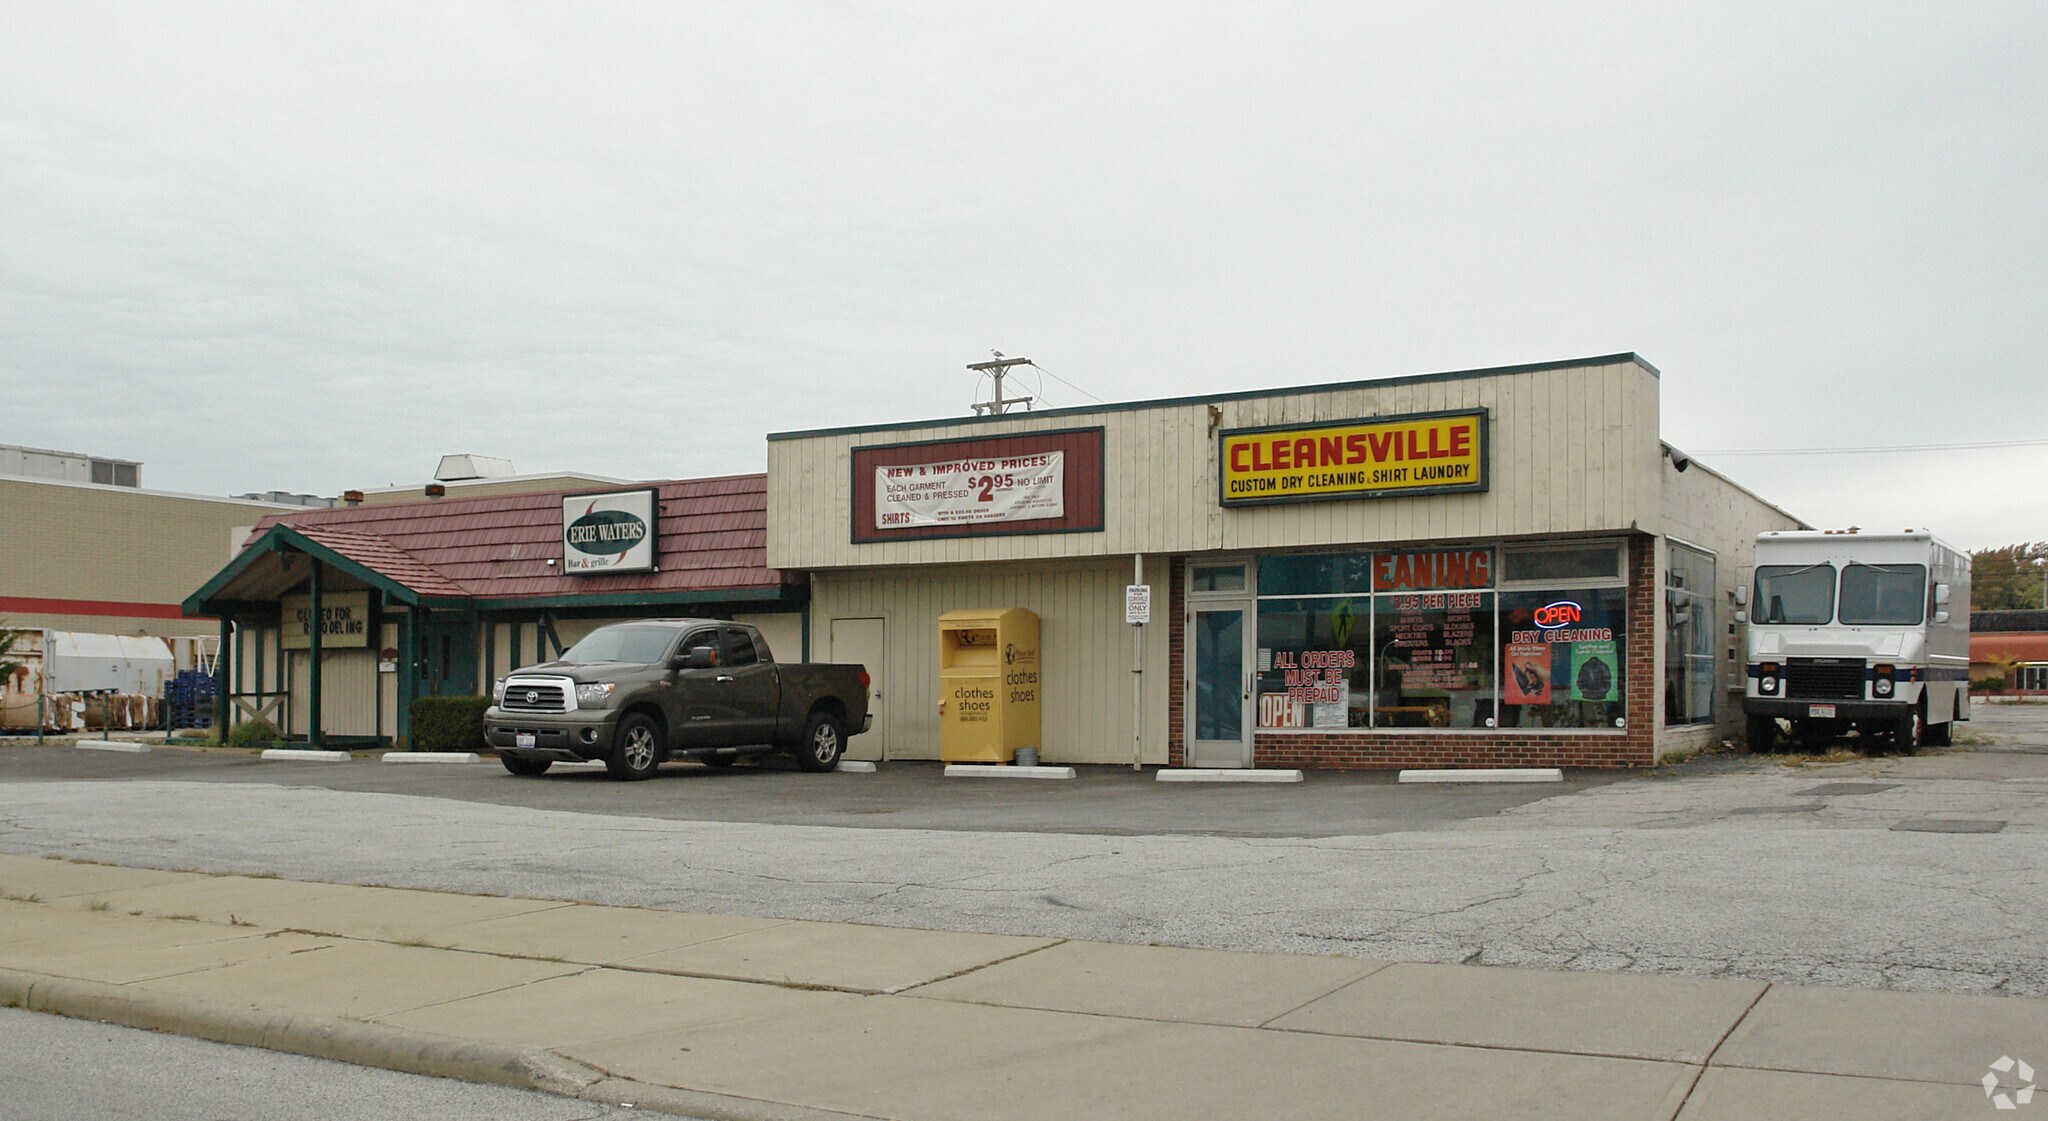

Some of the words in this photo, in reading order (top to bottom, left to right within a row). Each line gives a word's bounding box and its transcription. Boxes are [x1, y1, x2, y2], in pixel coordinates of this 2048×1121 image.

[1231, 425, 1470, 472] CLEANSVILLE
[887, 468, 913, 478] NEW
[919, 466, 927, 476] &
[933, 461, 995, 475] IMPROVED
[1001, 455, 1051, 469] PRICES!
[1017, 478, 1030, 486] NO
[1033, 475, 1054, 485] LIMIT
[1231, 478, 1276, 492] CUSTOM
[1281, 476, 1303, 489] DRY
[1308, 471, 1365, 487] CLEANING
[1372, 468, 1408, 483] SHIRT
[1413, 464, 1470, 480] LAUNDRY
[887, 483, 907, 493] EACH
[909, 481, 946, 491] GARMENT
[887, 493, 922, 503] CLEANED
[924, 492, 930, 500] &
[932, 489, 969, 500] PRESSED
[882, 512, 910, 525] SHIRTS
[570, 524, 597, 543] ERIE
[598, 521, 643, 541] WATERS
[568, 560, 581, 568] Bar
[581, 558, 589, 568] &
[590, 558, 609, 568] grille
[1374, 550, 1488, 590] EANING
[1423, 594, 1445, 609] PER
[1448, 593, 1481, 608] PIECE
[296, 607, 332, 622] CLED
[335, 607, 351, 620] FOR
[1534, 606, 1581, 624] OPEN
[303, 621, 362, 635] RODELING
[1512, 630, 1541, 643] DRY
[1544, 628, 1612, 642] CLEANING
[1274, 651, 1297, 669] ALL
[1301, 650, 1355, 668] ORDERS
[1006, 668, 1037, 686] clothes
[1285, 669, 1321, 687] MUST
[1325, 669, 1343, 685] BE
[954, 687, 994, 699] clothes
[1010, 687, 1035, 703] shoes
[1289, 687, 1340, 704] PREPAID
[959, 700, 990, 711] shoes
[1261, 695, 1301, 727] OPEN
